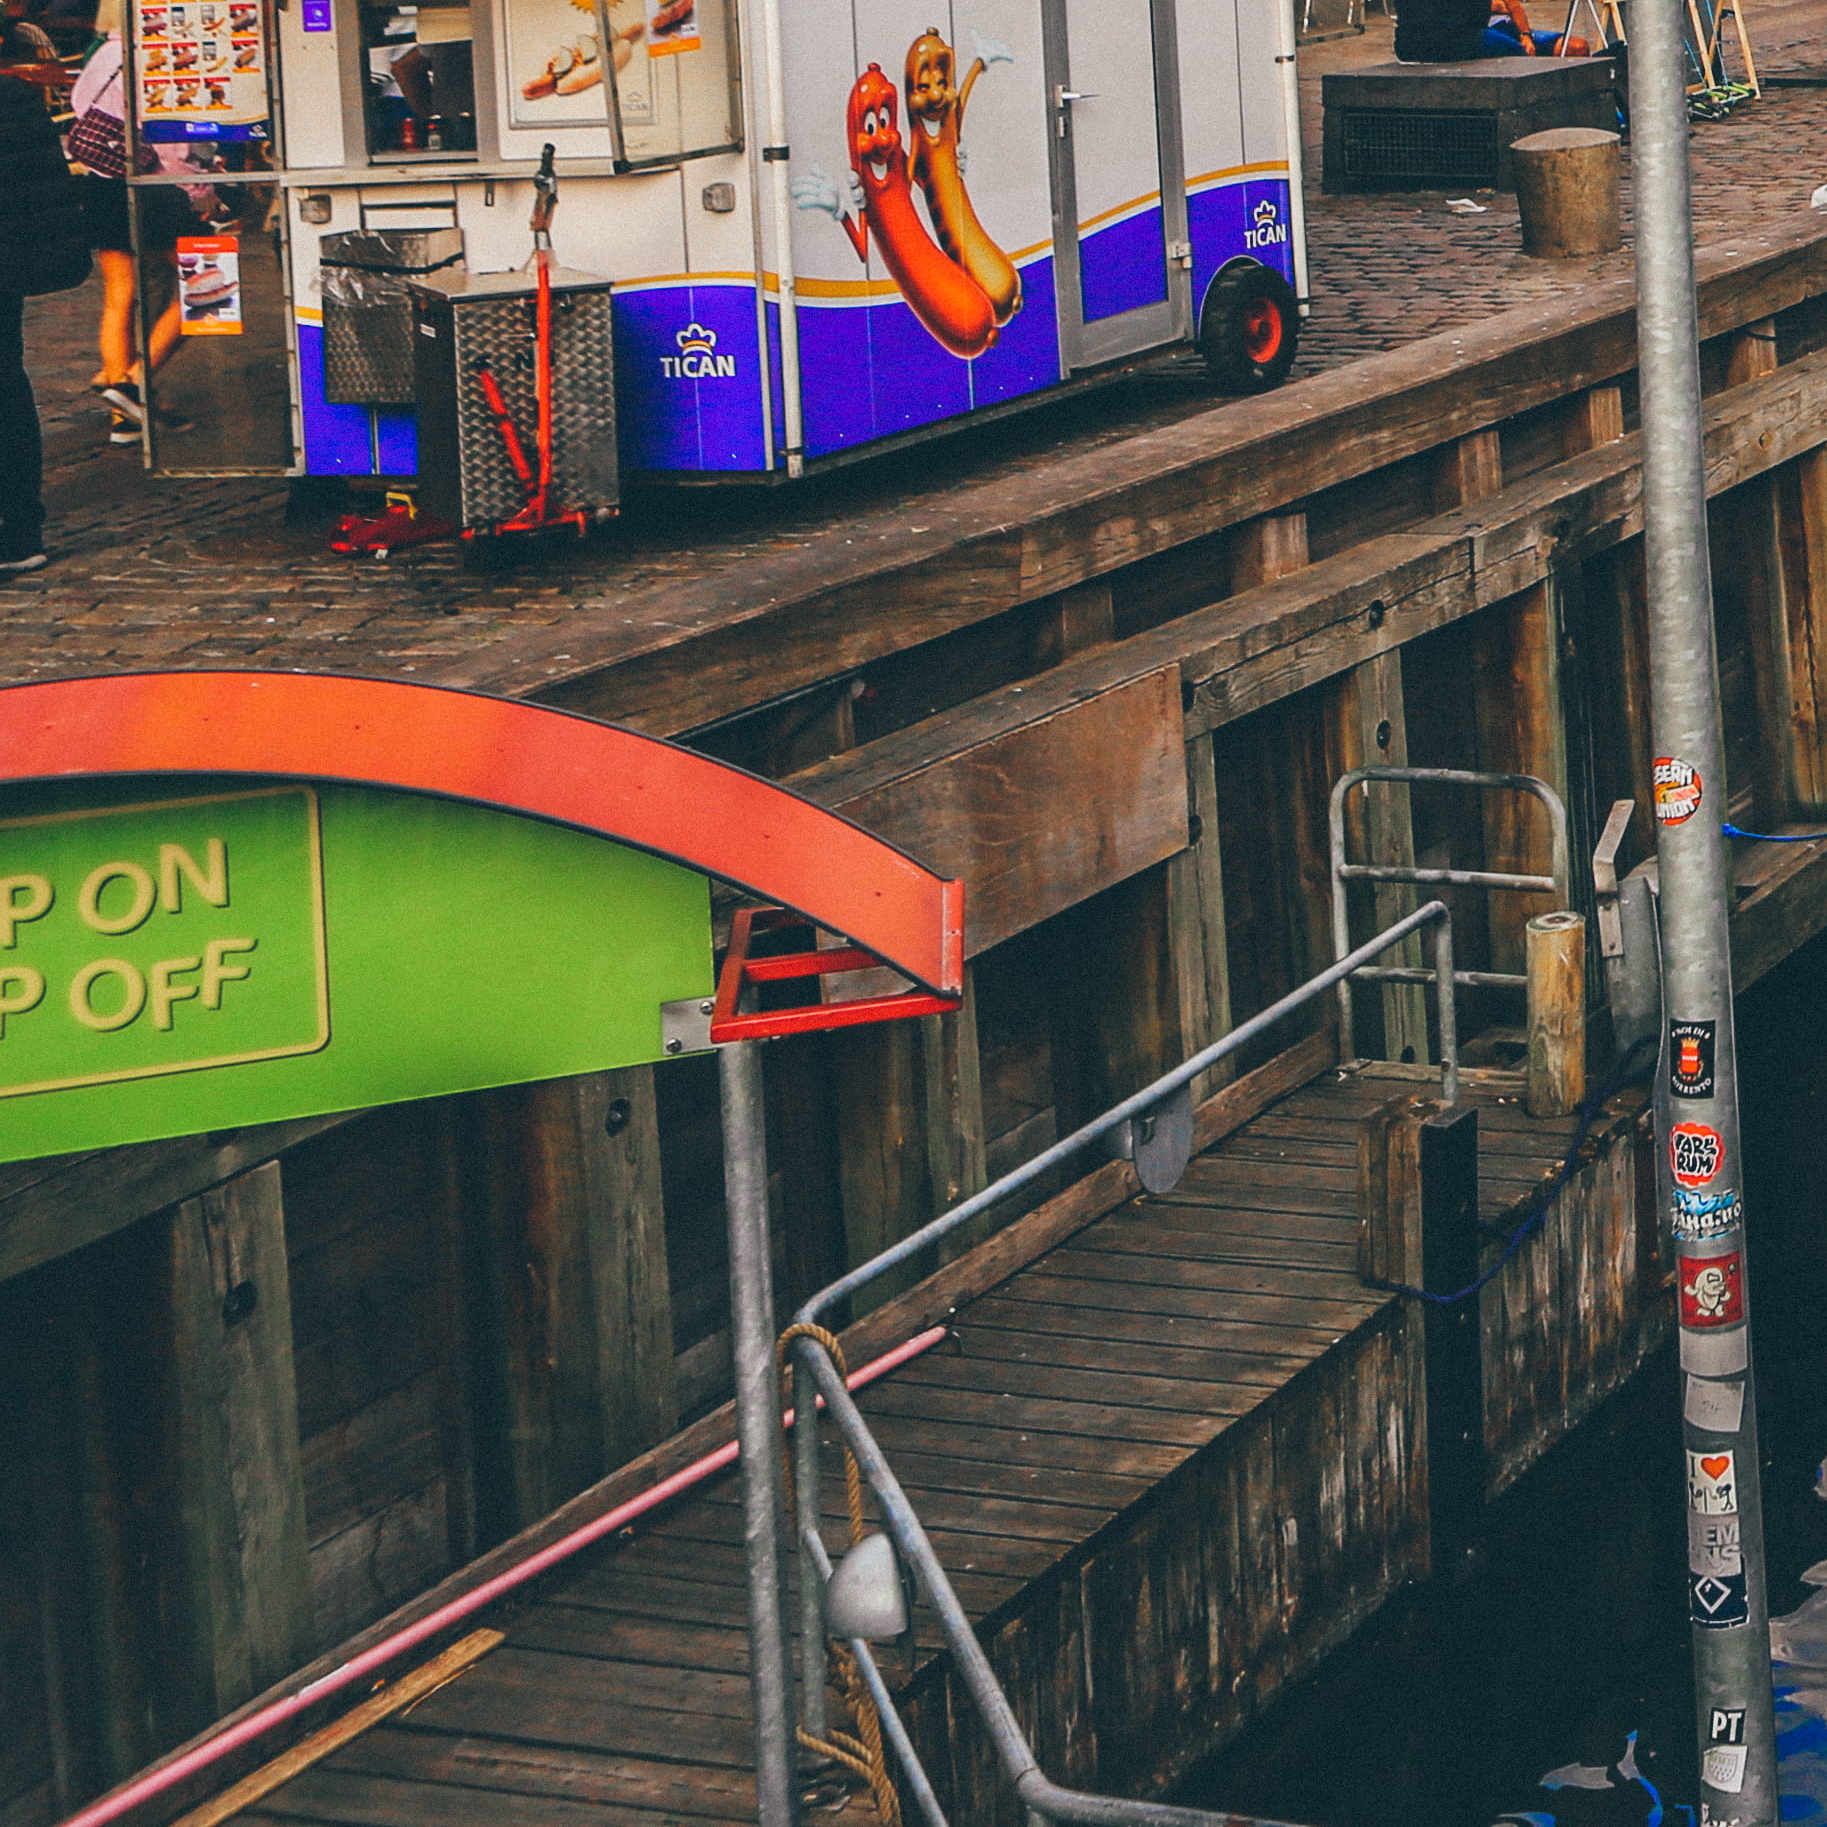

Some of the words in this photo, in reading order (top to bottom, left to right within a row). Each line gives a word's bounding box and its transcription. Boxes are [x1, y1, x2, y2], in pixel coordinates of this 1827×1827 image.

[1243, 223, 1288, 249] TICAN
[660, 354, 736, 379] TICAN
[78, 838, 230, 936] ON
[70, 938, 259, 1033] OFF
[1677, 1152, 1713, 1174] RUM
[1711, 1710, 1743, 1742] PT
